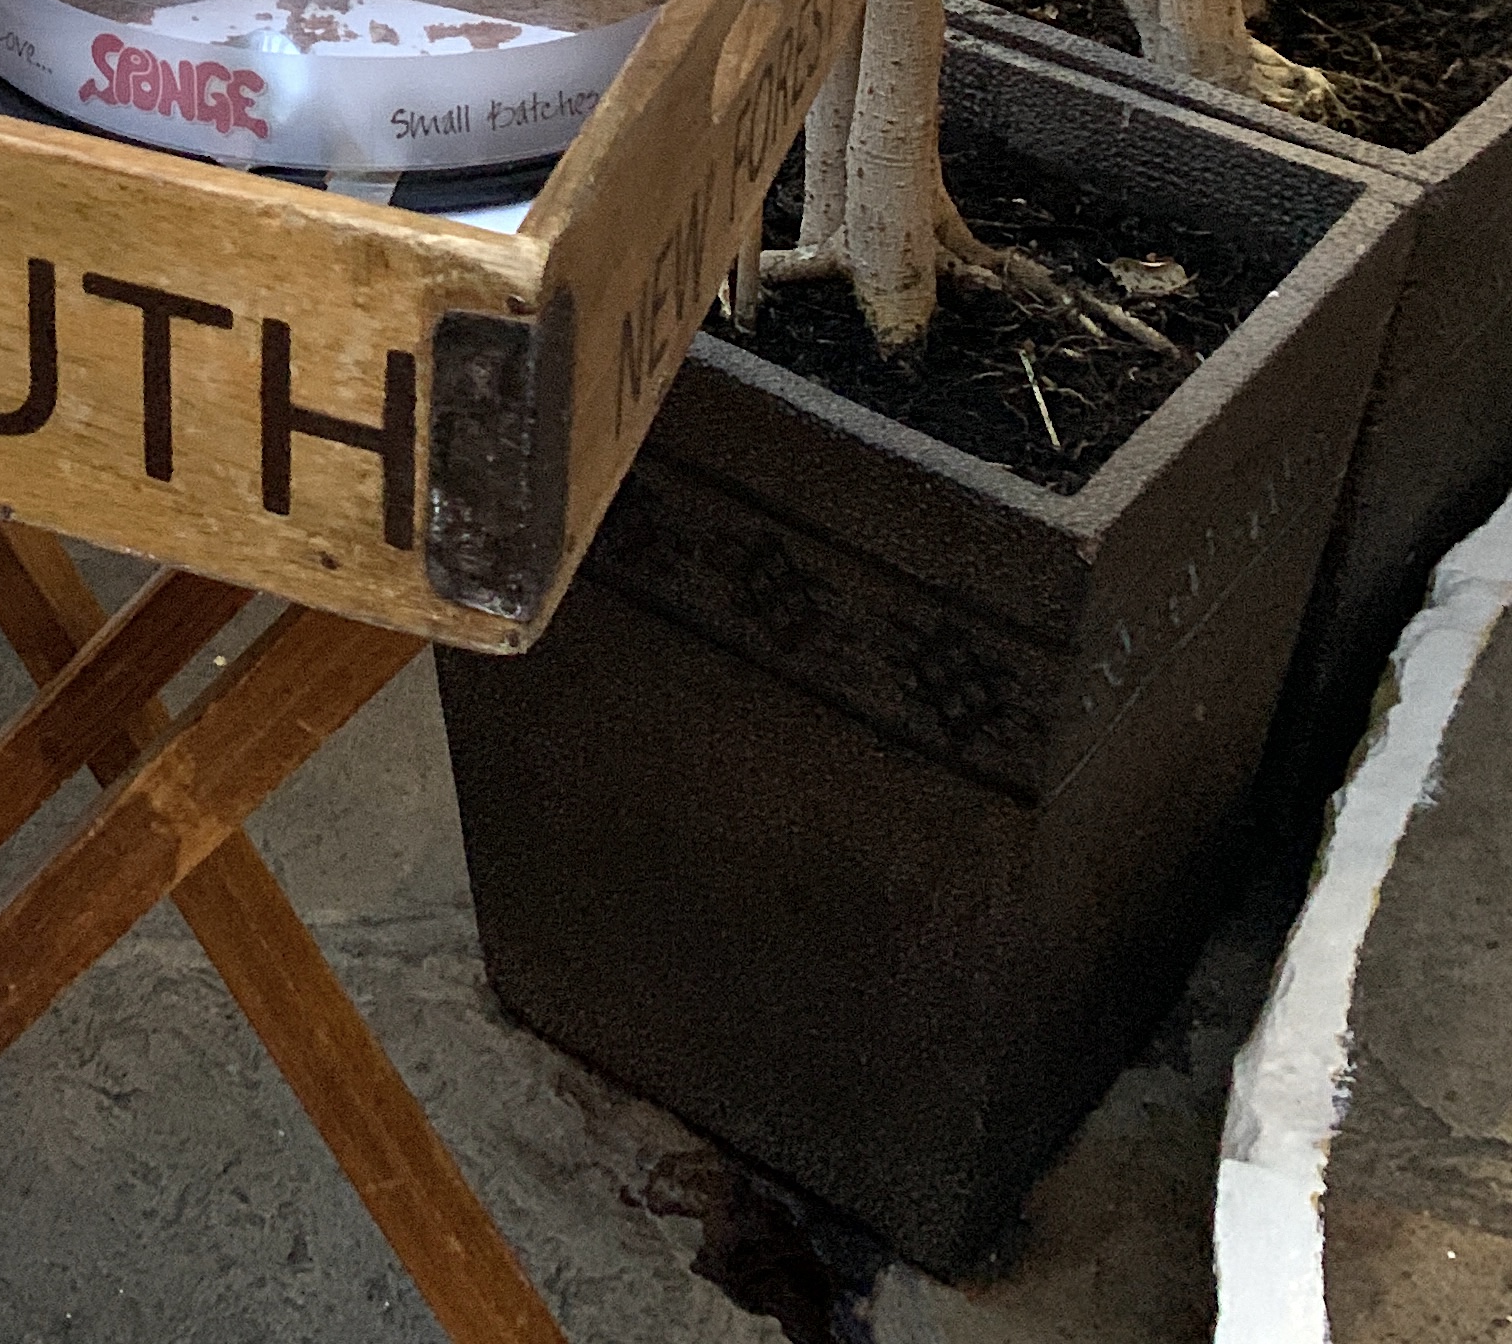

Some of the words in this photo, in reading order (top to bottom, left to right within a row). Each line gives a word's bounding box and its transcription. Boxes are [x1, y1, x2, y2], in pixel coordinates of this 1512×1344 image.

[78, 32, 269, 140] SPONGE
[391, 104, 471, 140] Small
[615, 159, 716, 441] NEW
